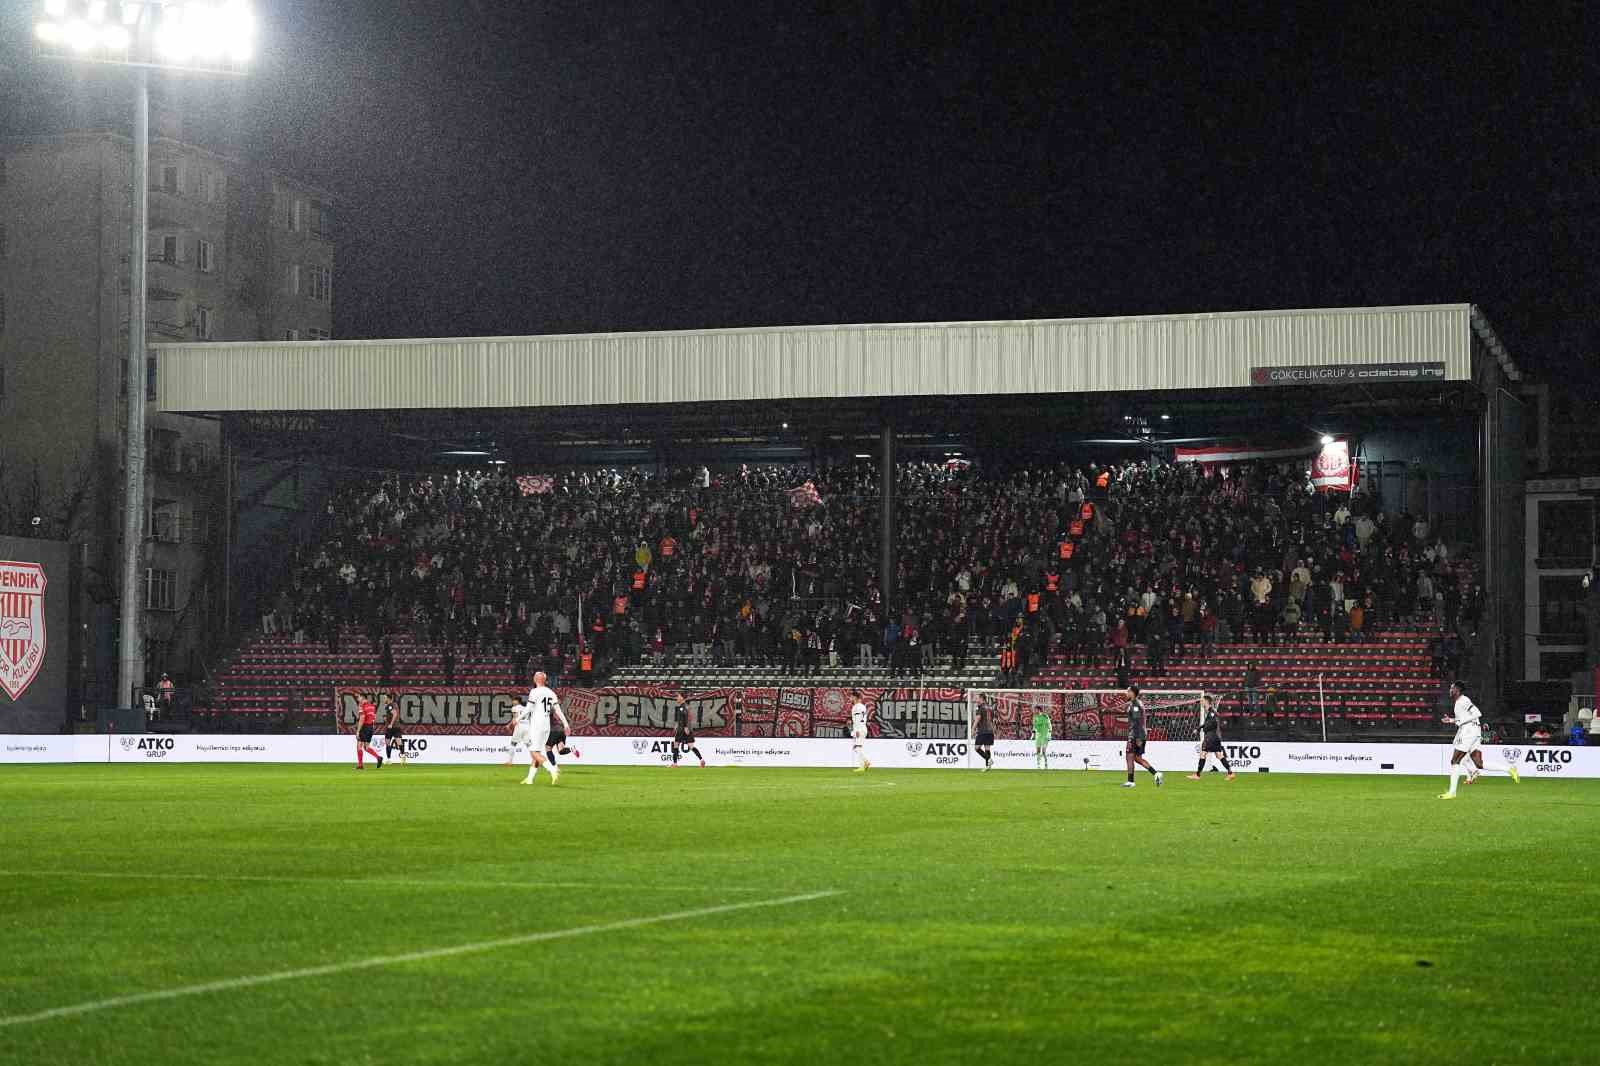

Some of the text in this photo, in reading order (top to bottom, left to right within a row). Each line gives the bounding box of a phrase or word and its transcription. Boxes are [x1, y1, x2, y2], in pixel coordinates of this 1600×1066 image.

[0, 570, 39, 589] ENDiK
[541, 696, 553, 713] 15
[881, 700, 976, 721] OFFENSIV
[137, 738, 175, 750] ATKO
[650, 740, 691, 753] ATO
[925, 743, 968, 756] ATKO
[146, 750, 168, 758] GRUP
[660, 754, 683, 762] GRP
[1221, 745, 1261, 759] TKO
[1524, 749, 1573, 763] ATKO
[936, 756, 959, 764] GRUP
[1536, 764, 1563, 772] GRUP
